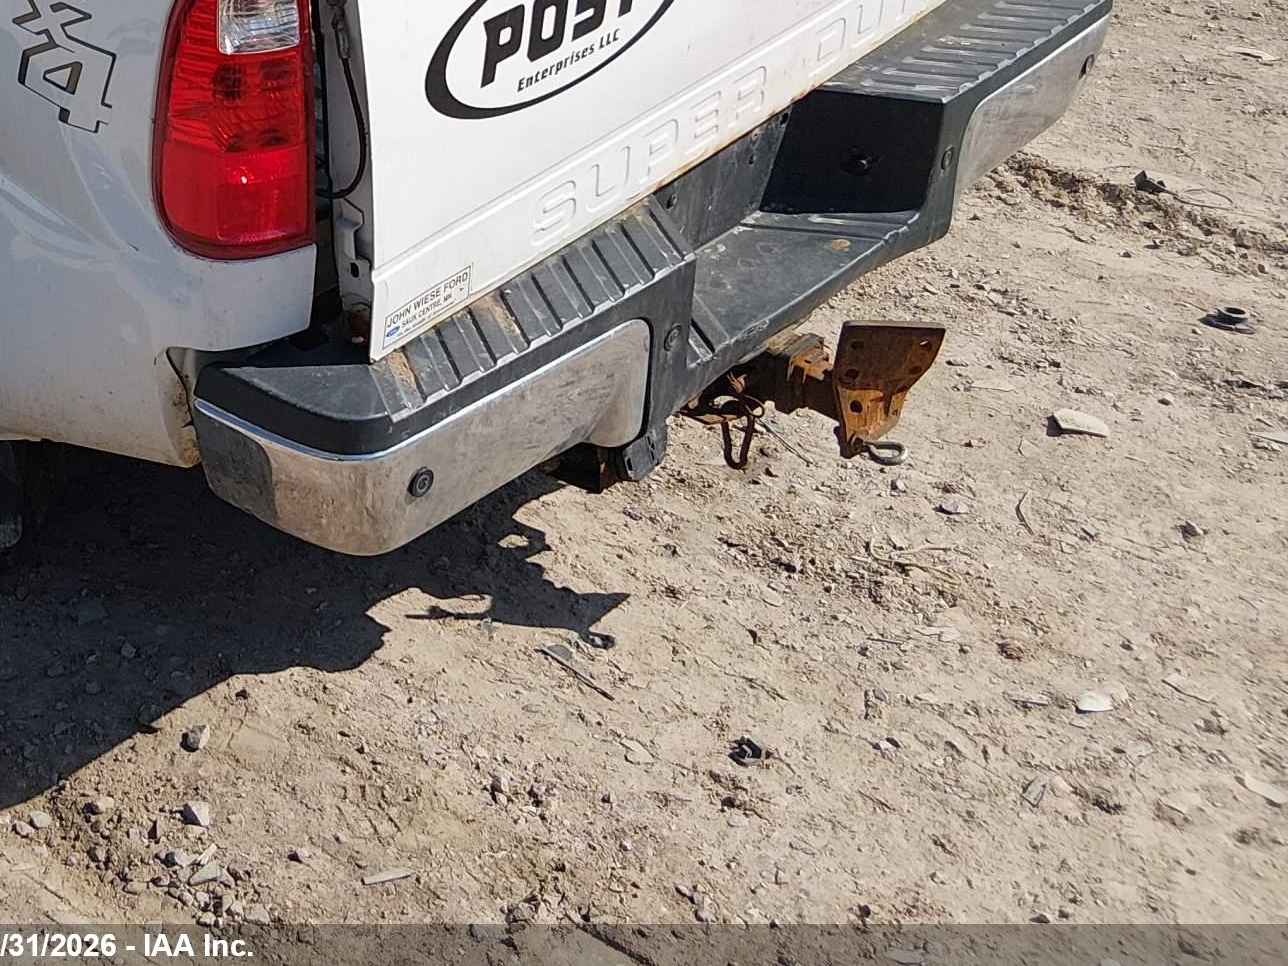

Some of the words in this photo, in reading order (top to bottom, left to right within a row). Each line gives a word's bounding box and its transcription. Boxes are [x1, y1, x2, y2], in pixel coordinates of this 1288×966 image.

[516, 41, 595, 93] Enterprises
[598, 28, 622, 51] LLC
[530, 64, 768, 248] SUPER
[386, 304, 412, 328] JOHN
[413, 283, 442, 311] WIESE
[443, 272, 469, 292] FORD
